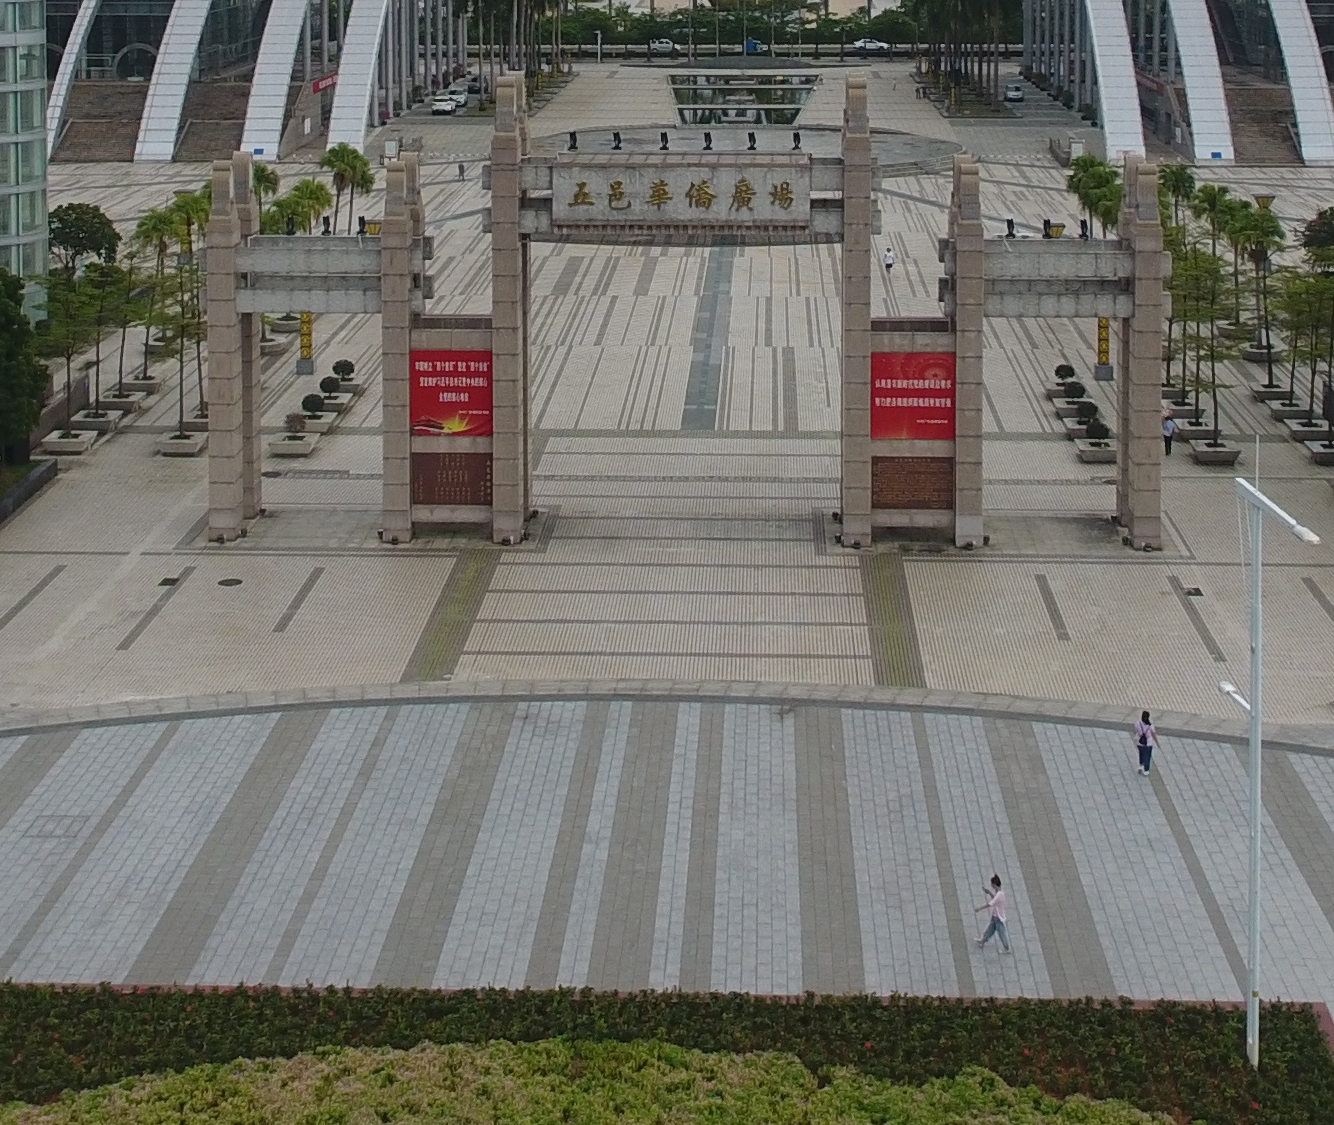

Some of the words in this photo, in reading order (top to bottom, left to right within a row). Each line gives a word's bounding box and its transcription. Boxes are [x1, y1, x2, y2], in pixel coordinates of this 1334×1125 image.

[568, 176, 795, 212] 五邑華僑廣場
